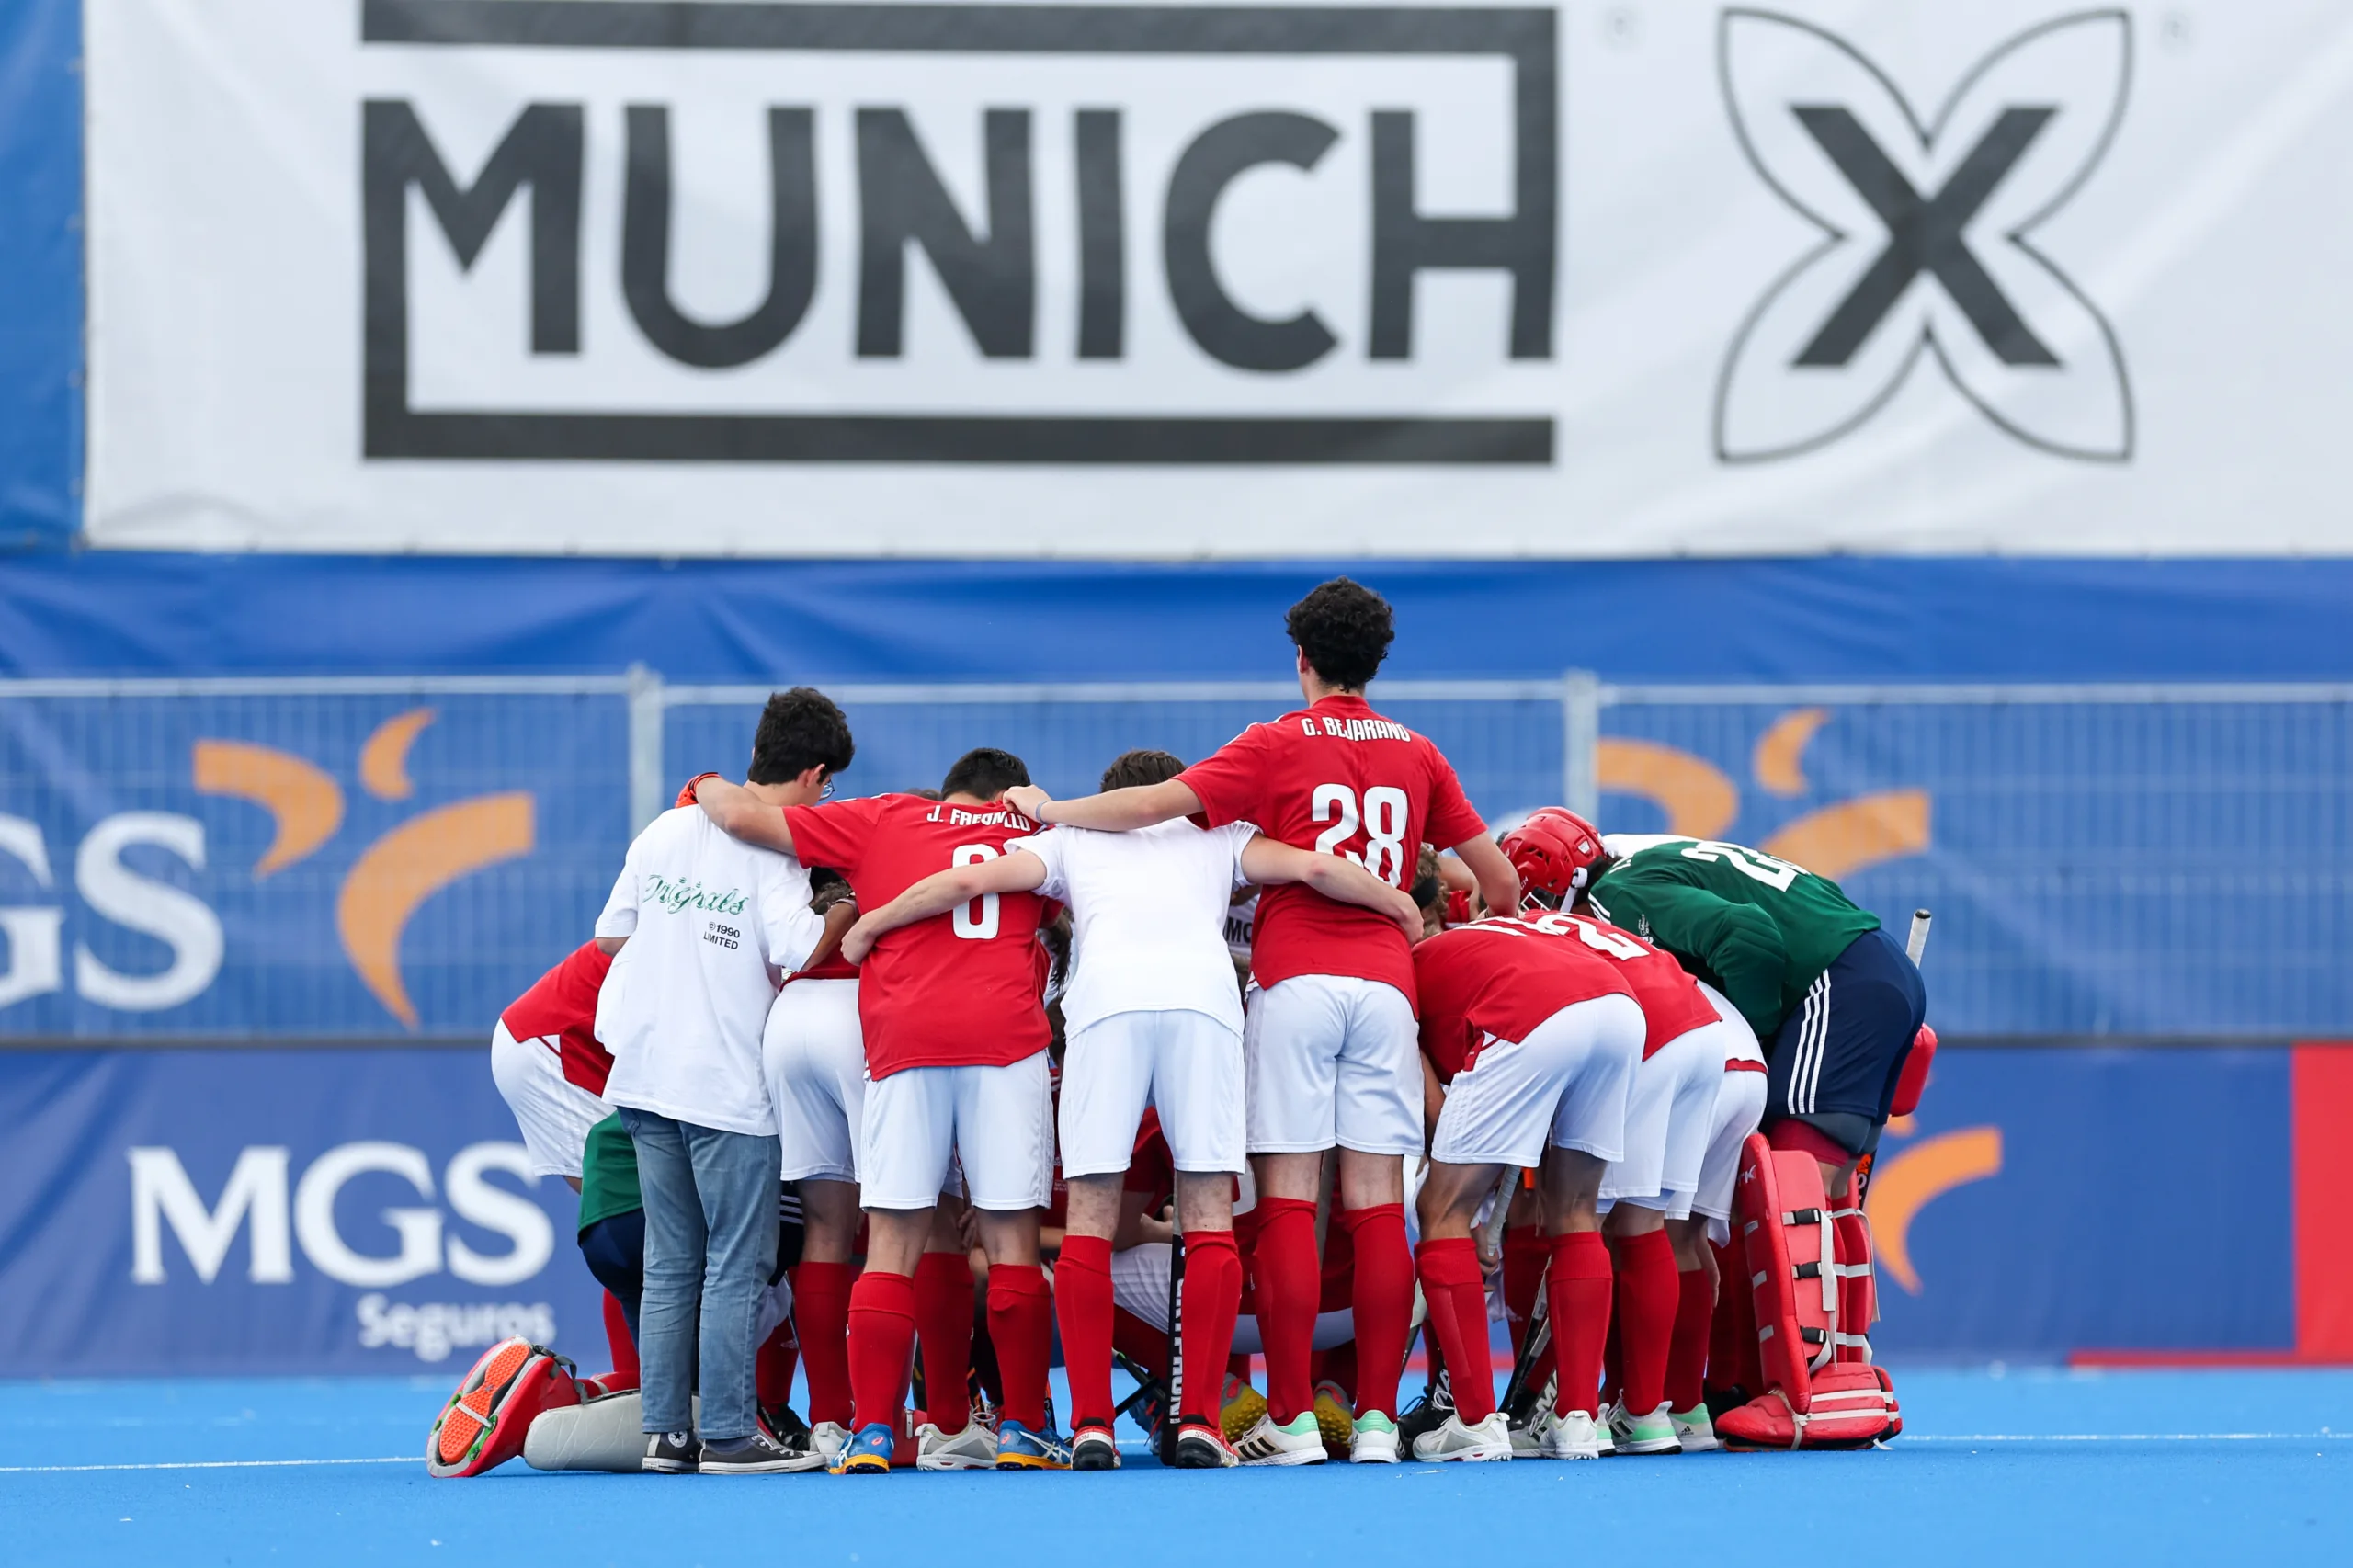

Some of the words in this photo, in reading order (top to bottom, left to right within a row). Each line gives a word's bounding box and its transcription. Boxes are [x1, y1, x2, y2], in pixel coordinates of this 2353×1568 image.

[360, 97, 1557, 372] MUNICH
[1301, 717, 1322, 736] G.
[1322, 717, 1411, 742] BEJARANO
[926, 804, 944, 822] J.
[1312, 783, 1409, 888] 28
[703, 931, 739, 949] LIMITED
[126, 1140, 554, 1287] MGS
[357, 1291, 555, 1362] Seguros
